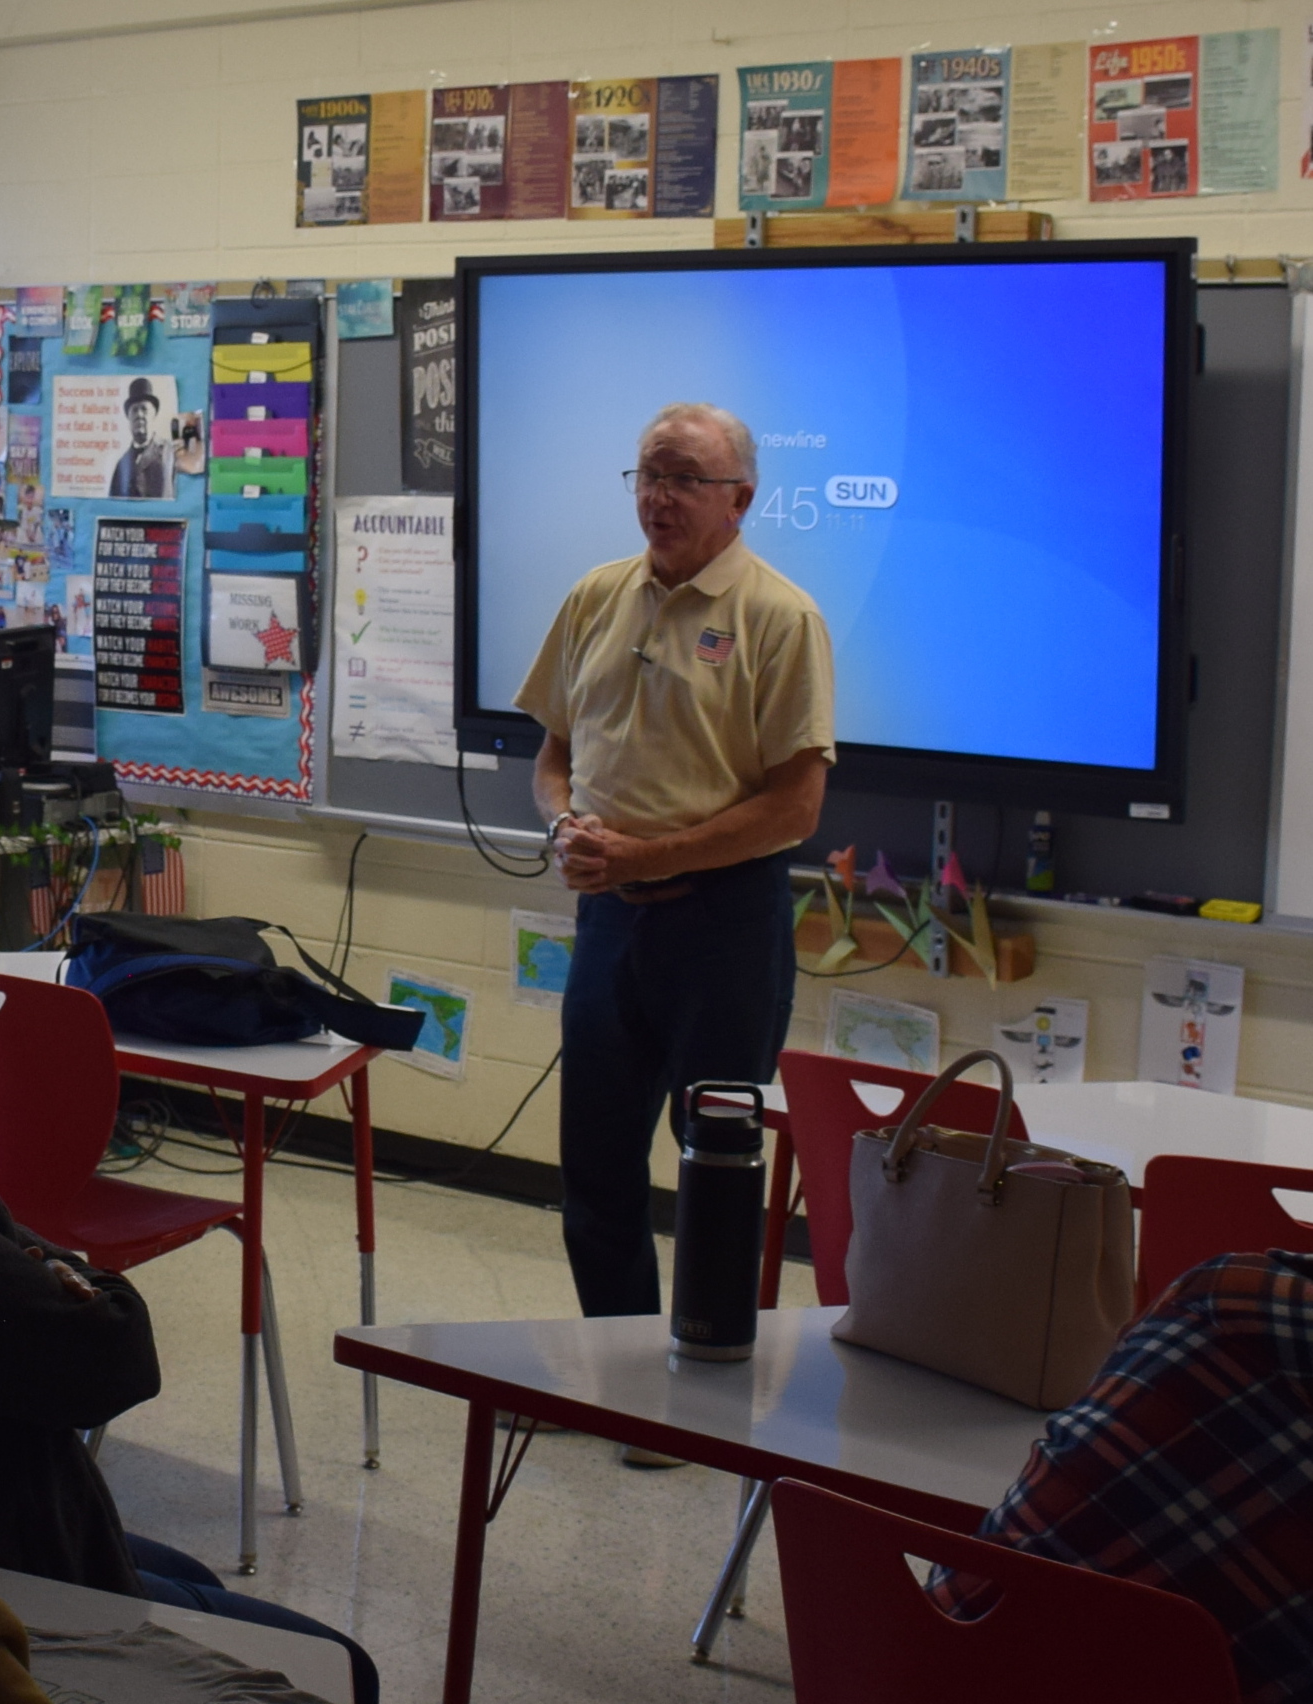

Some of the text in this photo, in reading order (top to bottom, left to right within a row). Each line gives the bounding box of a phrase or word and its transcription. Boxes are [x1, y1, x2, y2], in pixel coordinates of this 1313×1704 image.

[1130, 43, 1187, 75] 1950s
[941, 55, 1001, 80] 1940s
[773, 69, 824, 93] 1930s
[595, 84, 651, 107] 1920s
[319, 99, 367, 118] 1900s
[170, 314, 211, 328] STORY
[58, 387, 120, 397] Success is not
[82, 403, 111, 414] failure
[57, 421, 71, 431] not
[74, 421, 94, 431] fatal
[56, 439, 70, 449] the
[72, 439, 109, 452] courage
[760, 430, 827, 449] newline
[56, 457, 95, 466] continue
[57, 473, 73, 483] that
[835, 481, 887, 501] SUN
[353, 515, 445, 536] ACCOUNTABLE
[99, 527, 124, 541] WATCH
[125, 528, 145, 542] YOUR
[98, 542, 113, 556] FOR
[113, 543, 131, 557] THEY
[131, 543, 158, 558] BECOME
[97, 562, 125, 577] WATCH
[126, 564, 150, 578] YOUR
[96, 577, 109, 592] FOR
[110, 578, 125, 593] THEY
[126, 579, 152, 594] BECOME
[96, 598, 121, 613] WATCH
[123, 600, 144, 614] YOUR
[230, 592, 272, 608] MISSING
[96, 613, 109, 628] FOR
[110, 613, 126, 629] THEY
[126, 615, 152, 631] BECOME
[229, 617, 260, 630] WORK
[97, 635, 123, 650] WATCH
[125, 636, 146, 652] YOUR
[123, 652, 145, 667] BECOME
[120, 673, 138, 688] YOUR
[210, 682, 281, 706] AWESOME
[682, 1320, 707, 1335] YETI
